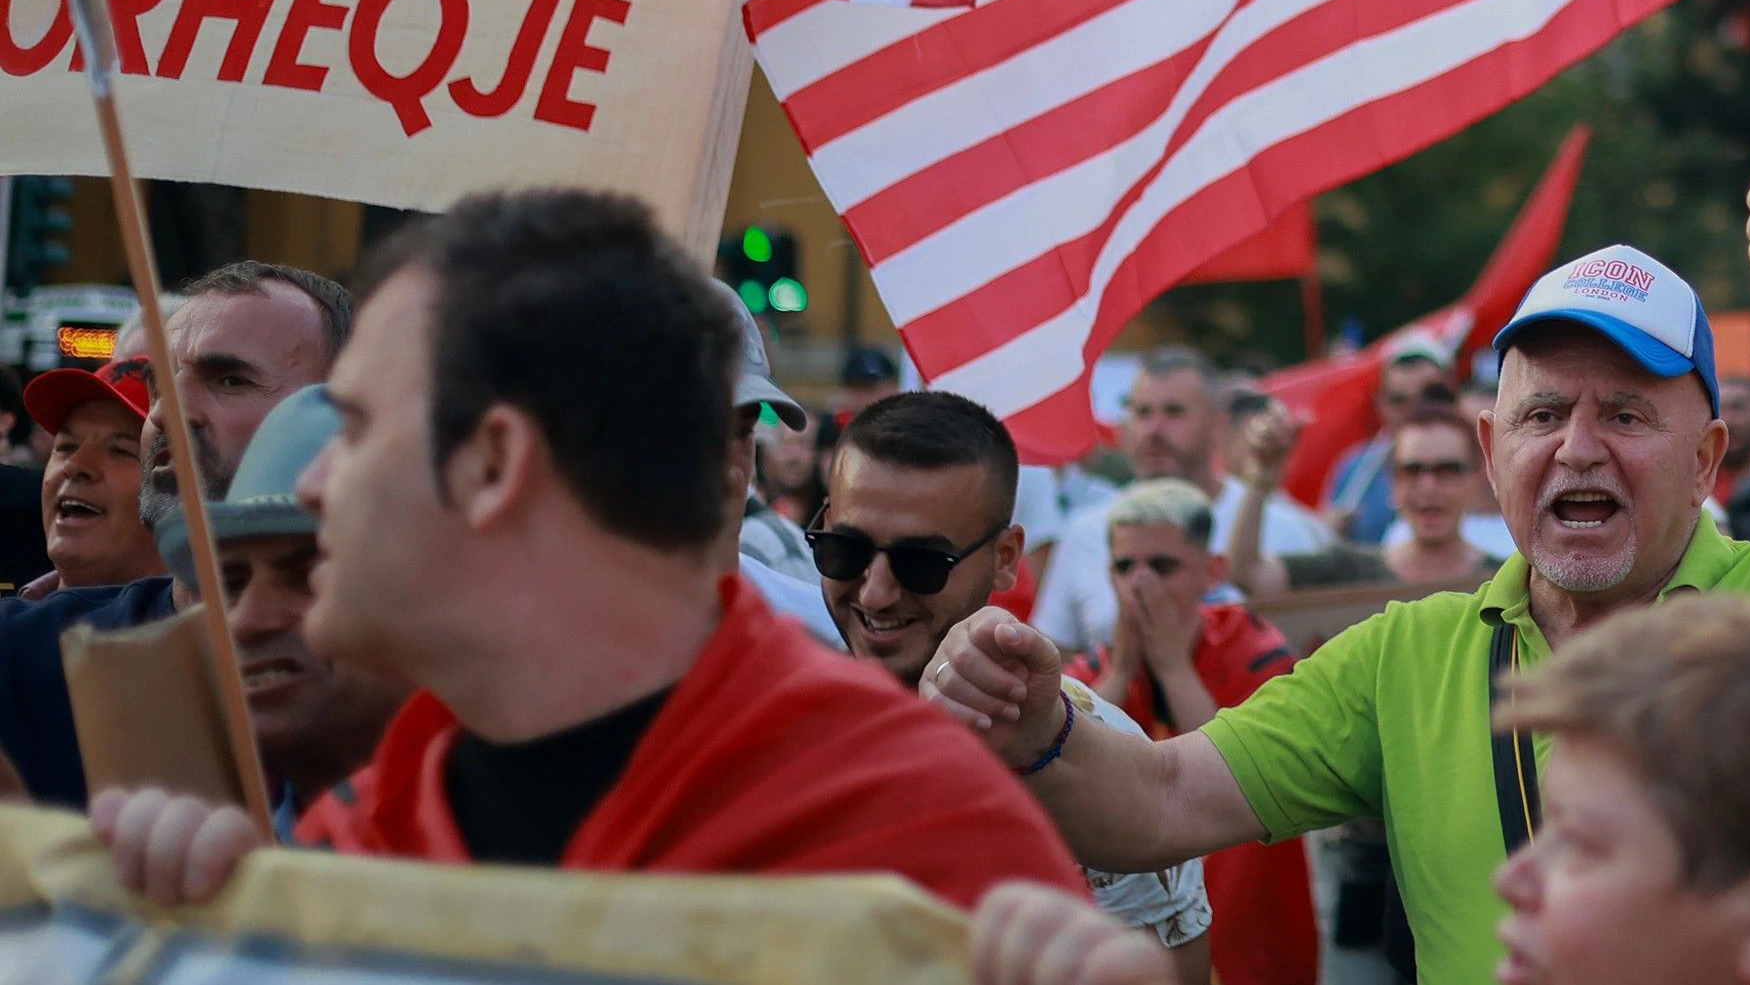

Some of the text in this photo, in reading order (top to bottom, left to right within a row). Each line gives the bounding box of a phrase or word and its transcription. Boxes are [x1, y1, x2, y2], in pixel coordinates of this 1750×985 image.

[1567, 259, 1656, 291] ICON
[1563, 277, 1649, 303] COLLEGE
[1574, 288, 1629, 302] LONDON
